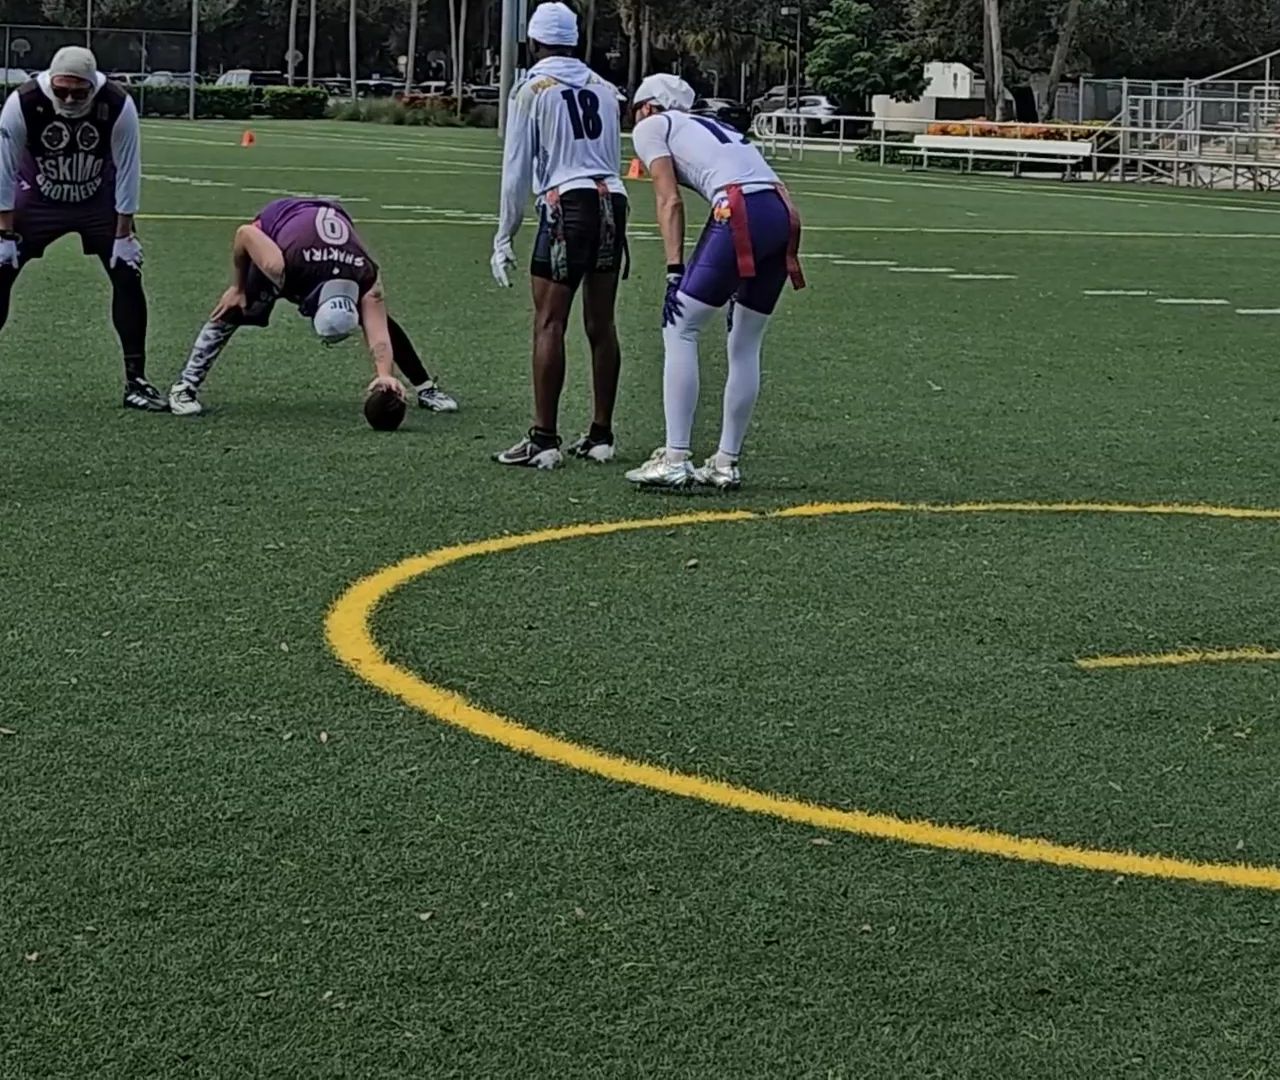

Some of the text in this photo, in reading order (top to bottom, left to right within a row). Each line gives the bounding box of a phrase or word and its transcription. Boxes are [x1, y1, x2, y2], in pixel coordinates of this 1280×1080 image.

[560, 89, 604, 140] 18
[35, 152, 104, 182] ESKIMO
[302, 247, 365, 267] SHAKIRA
